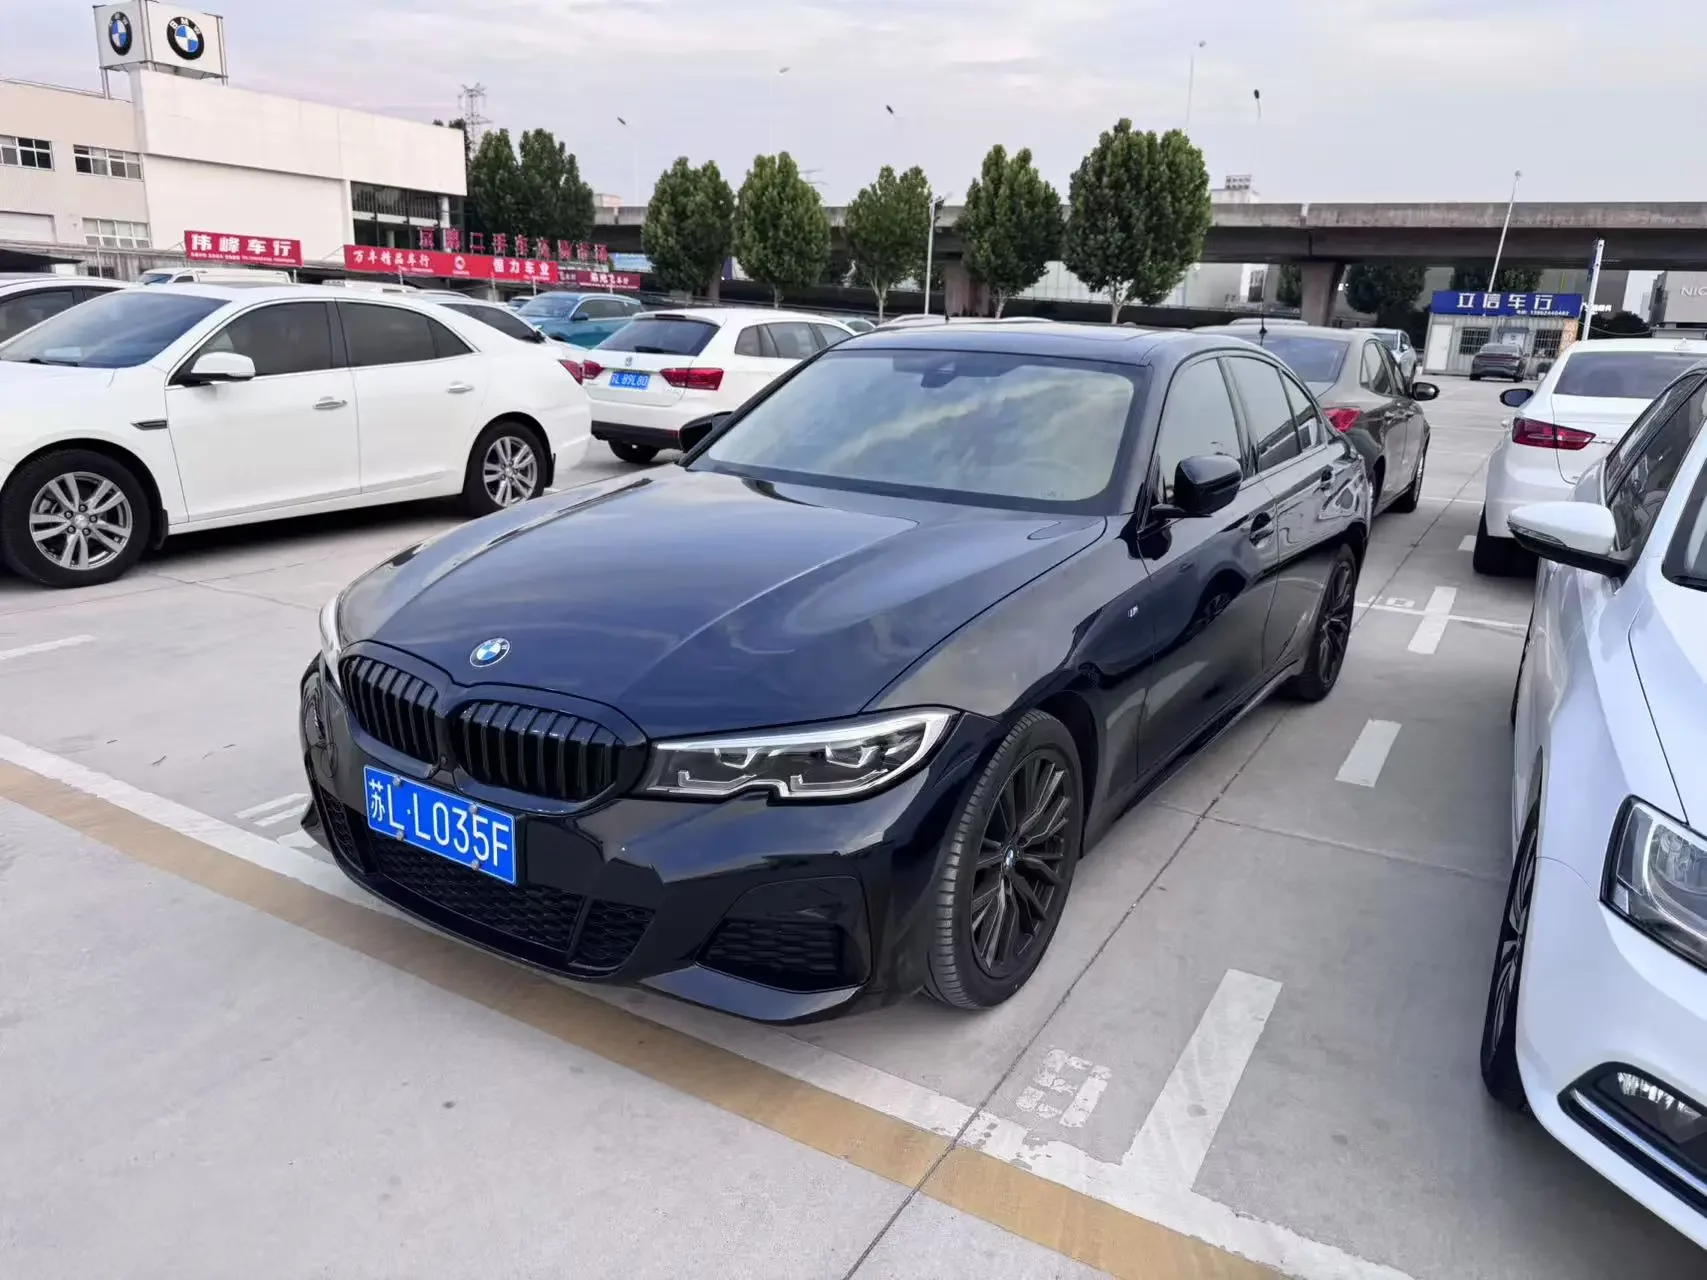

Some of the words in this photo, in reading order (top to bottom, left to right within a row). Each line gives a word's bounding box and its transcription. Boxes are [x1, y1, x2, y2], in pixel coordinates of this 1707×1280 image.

[191, 233, 292, 257] 伟峰车行
[1456, 292, 1553, 310] 立信车行
